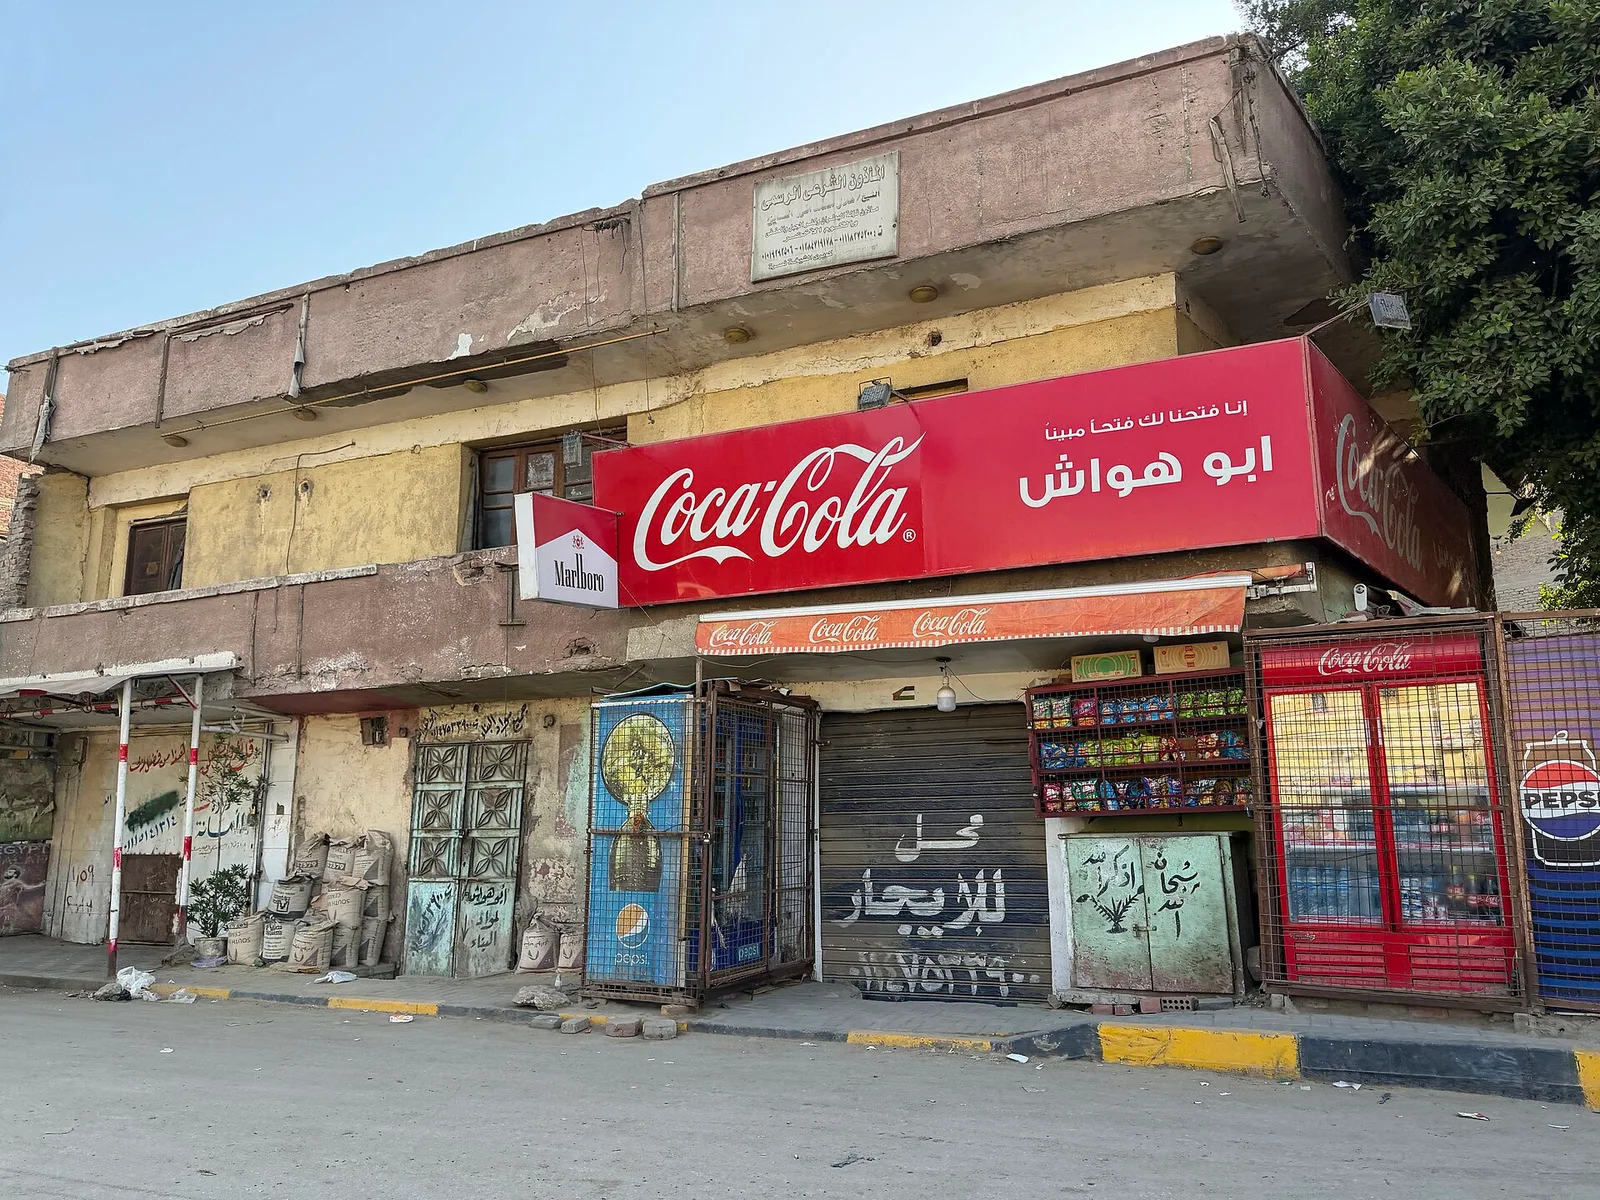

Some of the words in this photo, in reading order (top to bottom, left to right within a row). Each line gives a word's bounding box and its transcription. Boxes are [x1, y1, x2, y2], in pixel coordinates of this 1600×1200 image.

[1138, 411, 1165, 427] لك
[1168, 404, 1220, 424] فتحنا
[1223, 399, 1248, 417] إنا
[1202, 434, 1274, 487] ابو
[1018, 450, 1183, 509] هواش
[632, 431, 927, 572] Coca-Cola
[553, 552, 605, 593] Marlboro
[709, 620, 778, 648] Coca-Cola
[808, 613, 883, 644] Coca-Cola
[911, 606, 993, 638] Coca-Cola
[1317, 640, 1415, 677] Coca-Cola
[894, 813, 984, 862] محل
[614, 952, 650, 967] pepsi
[738, 946, 760, 961] pepsi
